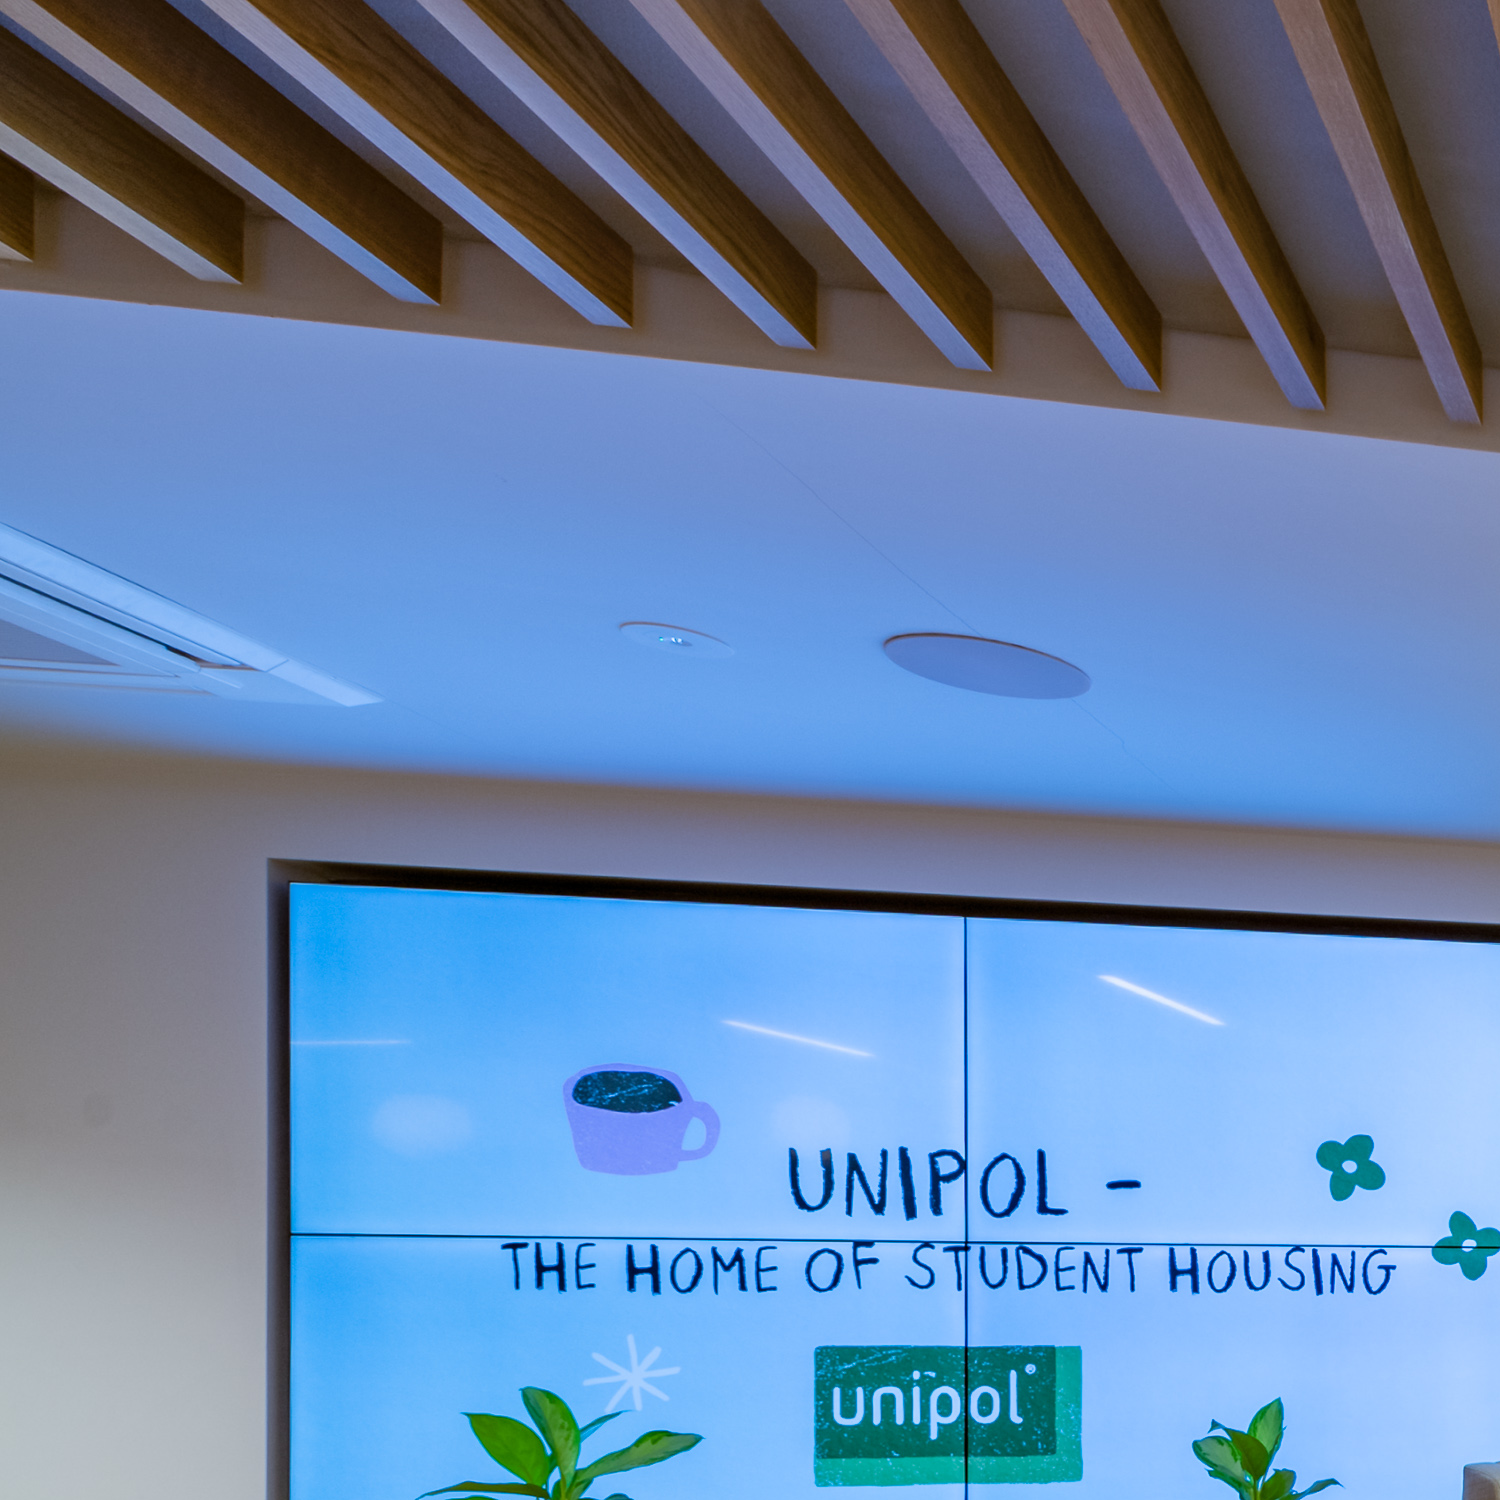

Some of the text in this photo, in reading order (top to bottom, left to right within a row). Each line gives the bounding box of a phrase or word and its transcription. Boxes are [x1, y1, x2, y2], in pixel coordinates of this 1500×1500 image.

[788, 1147, 1069, 1221] UNIPOL
[500, 1241, 1397, 1297] THE HOME OF STUDENT HOUSING
